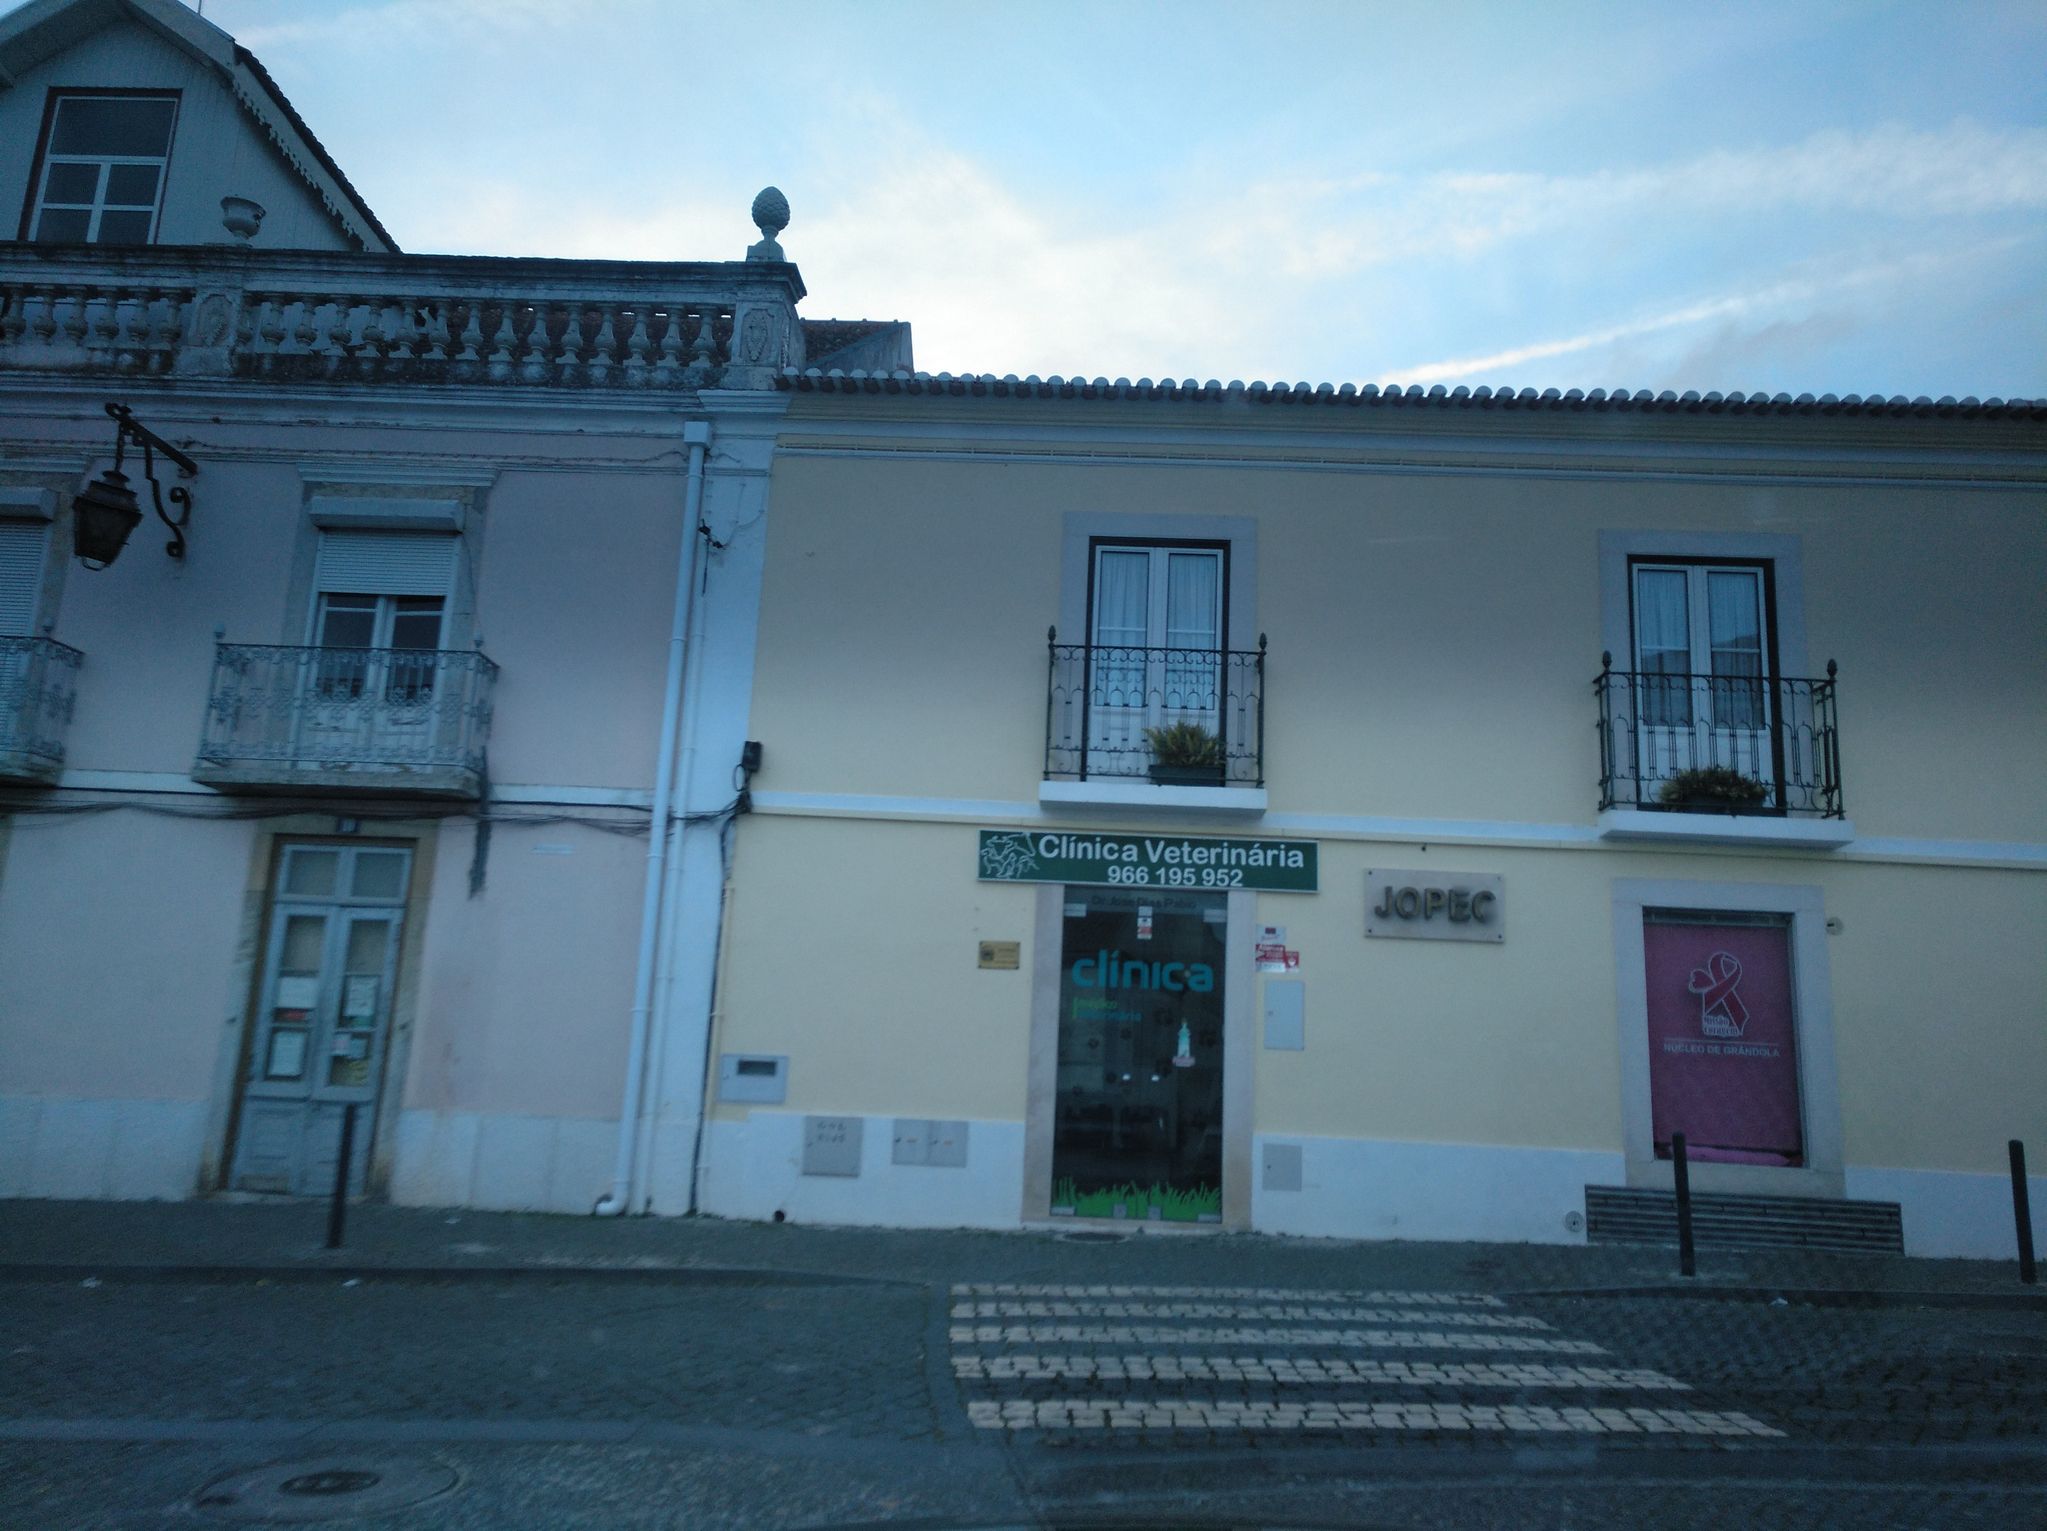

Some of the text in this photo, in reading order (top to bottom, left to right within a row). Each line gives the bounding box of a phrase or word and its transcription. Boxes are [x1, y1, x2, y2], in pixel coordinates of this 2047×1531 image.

[1038, 834, 1304, 868] Clínica Veterinária
[1107, 865, 1243, 888] 966 195 952
[1374, 886, 1497, 924] JOPEC
[1071, 949, 1214, 993] clínica
[1707, 1045, 1721, 1055] DE
